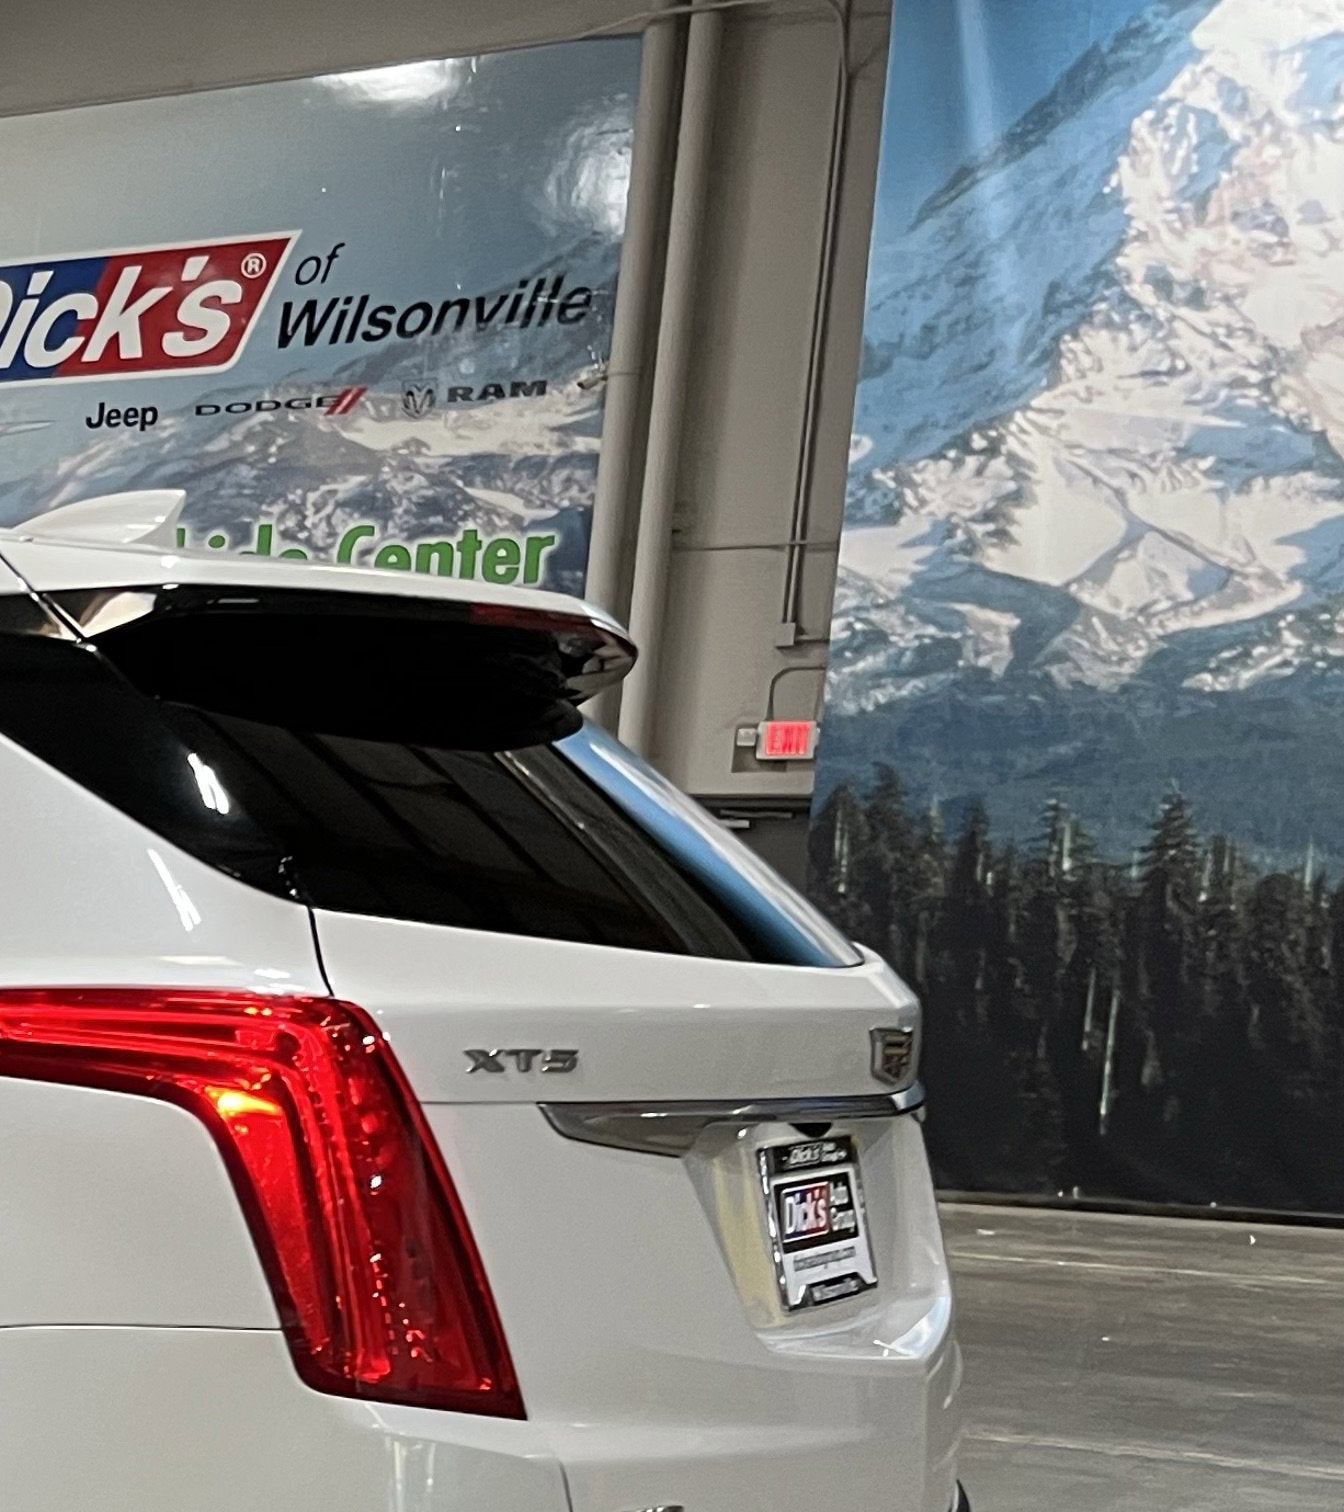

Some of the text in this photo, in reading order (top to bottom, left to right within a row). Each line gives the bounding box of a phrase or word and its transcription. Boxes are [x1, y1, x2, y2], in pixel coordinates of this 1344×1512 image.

[294, 242, 346, 286] of
[277, 272, 593, 349] Wilsonville
[195, 394, 341, 416] DODGE
[447, 380, 547, 403] RAM
[86, 402, 159, 432] Jeep
[337, 524, 555, 584] Center
[463, 1048, 579, 1073] XT5
[785, 1187, 827, 1235] Dick's
